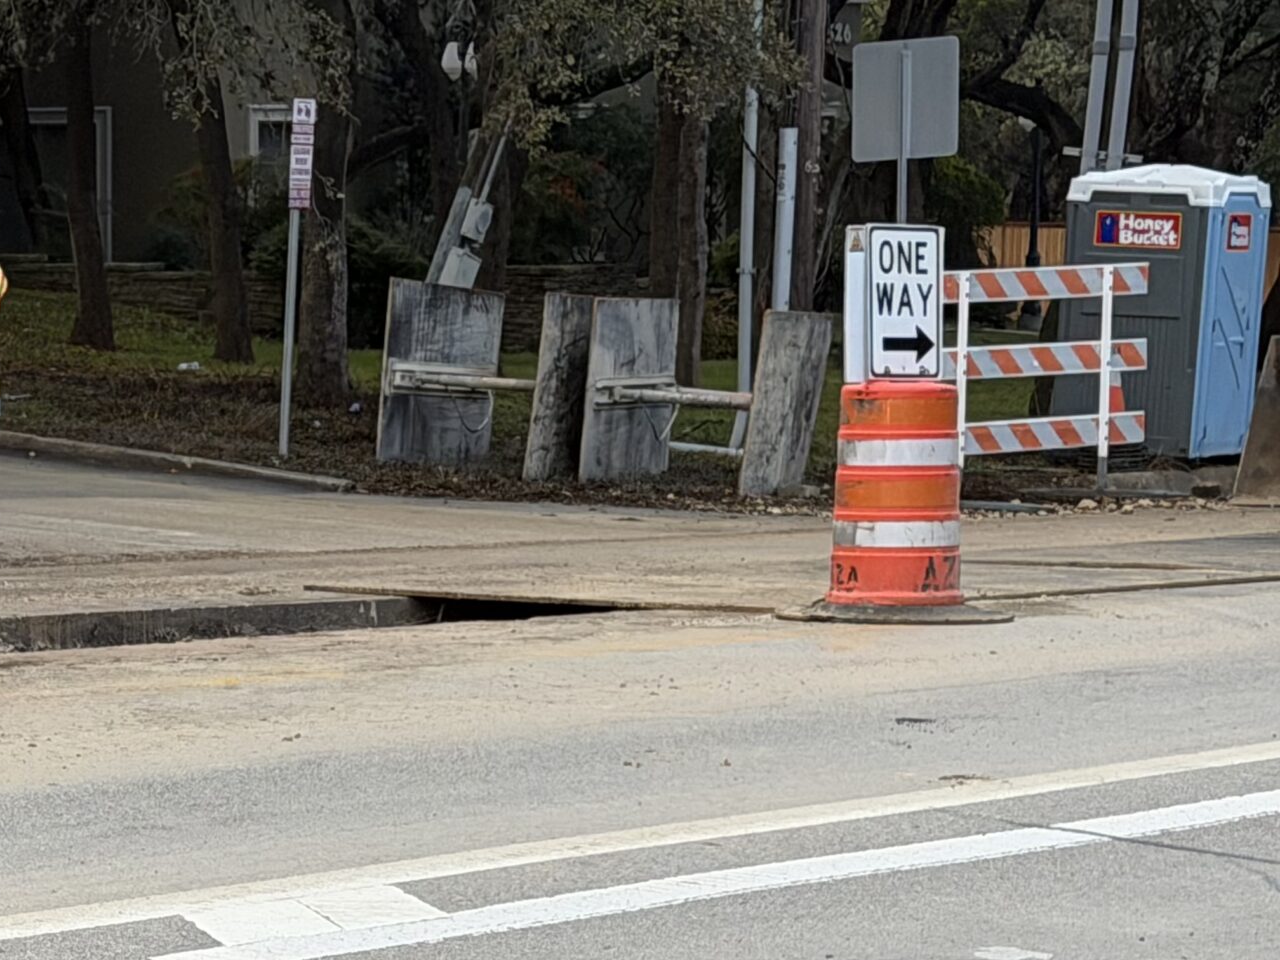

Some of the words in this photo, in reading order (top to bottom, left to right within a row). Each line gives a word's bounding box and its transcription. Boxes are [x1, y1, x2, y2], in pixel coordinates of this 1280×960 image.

[1119, 213, 1174, 233] Honey
[1118, 230, 1178, 246] Bucket
[879, 240, 928, 275] ONE
[876, 282, 933, 317] WAY
